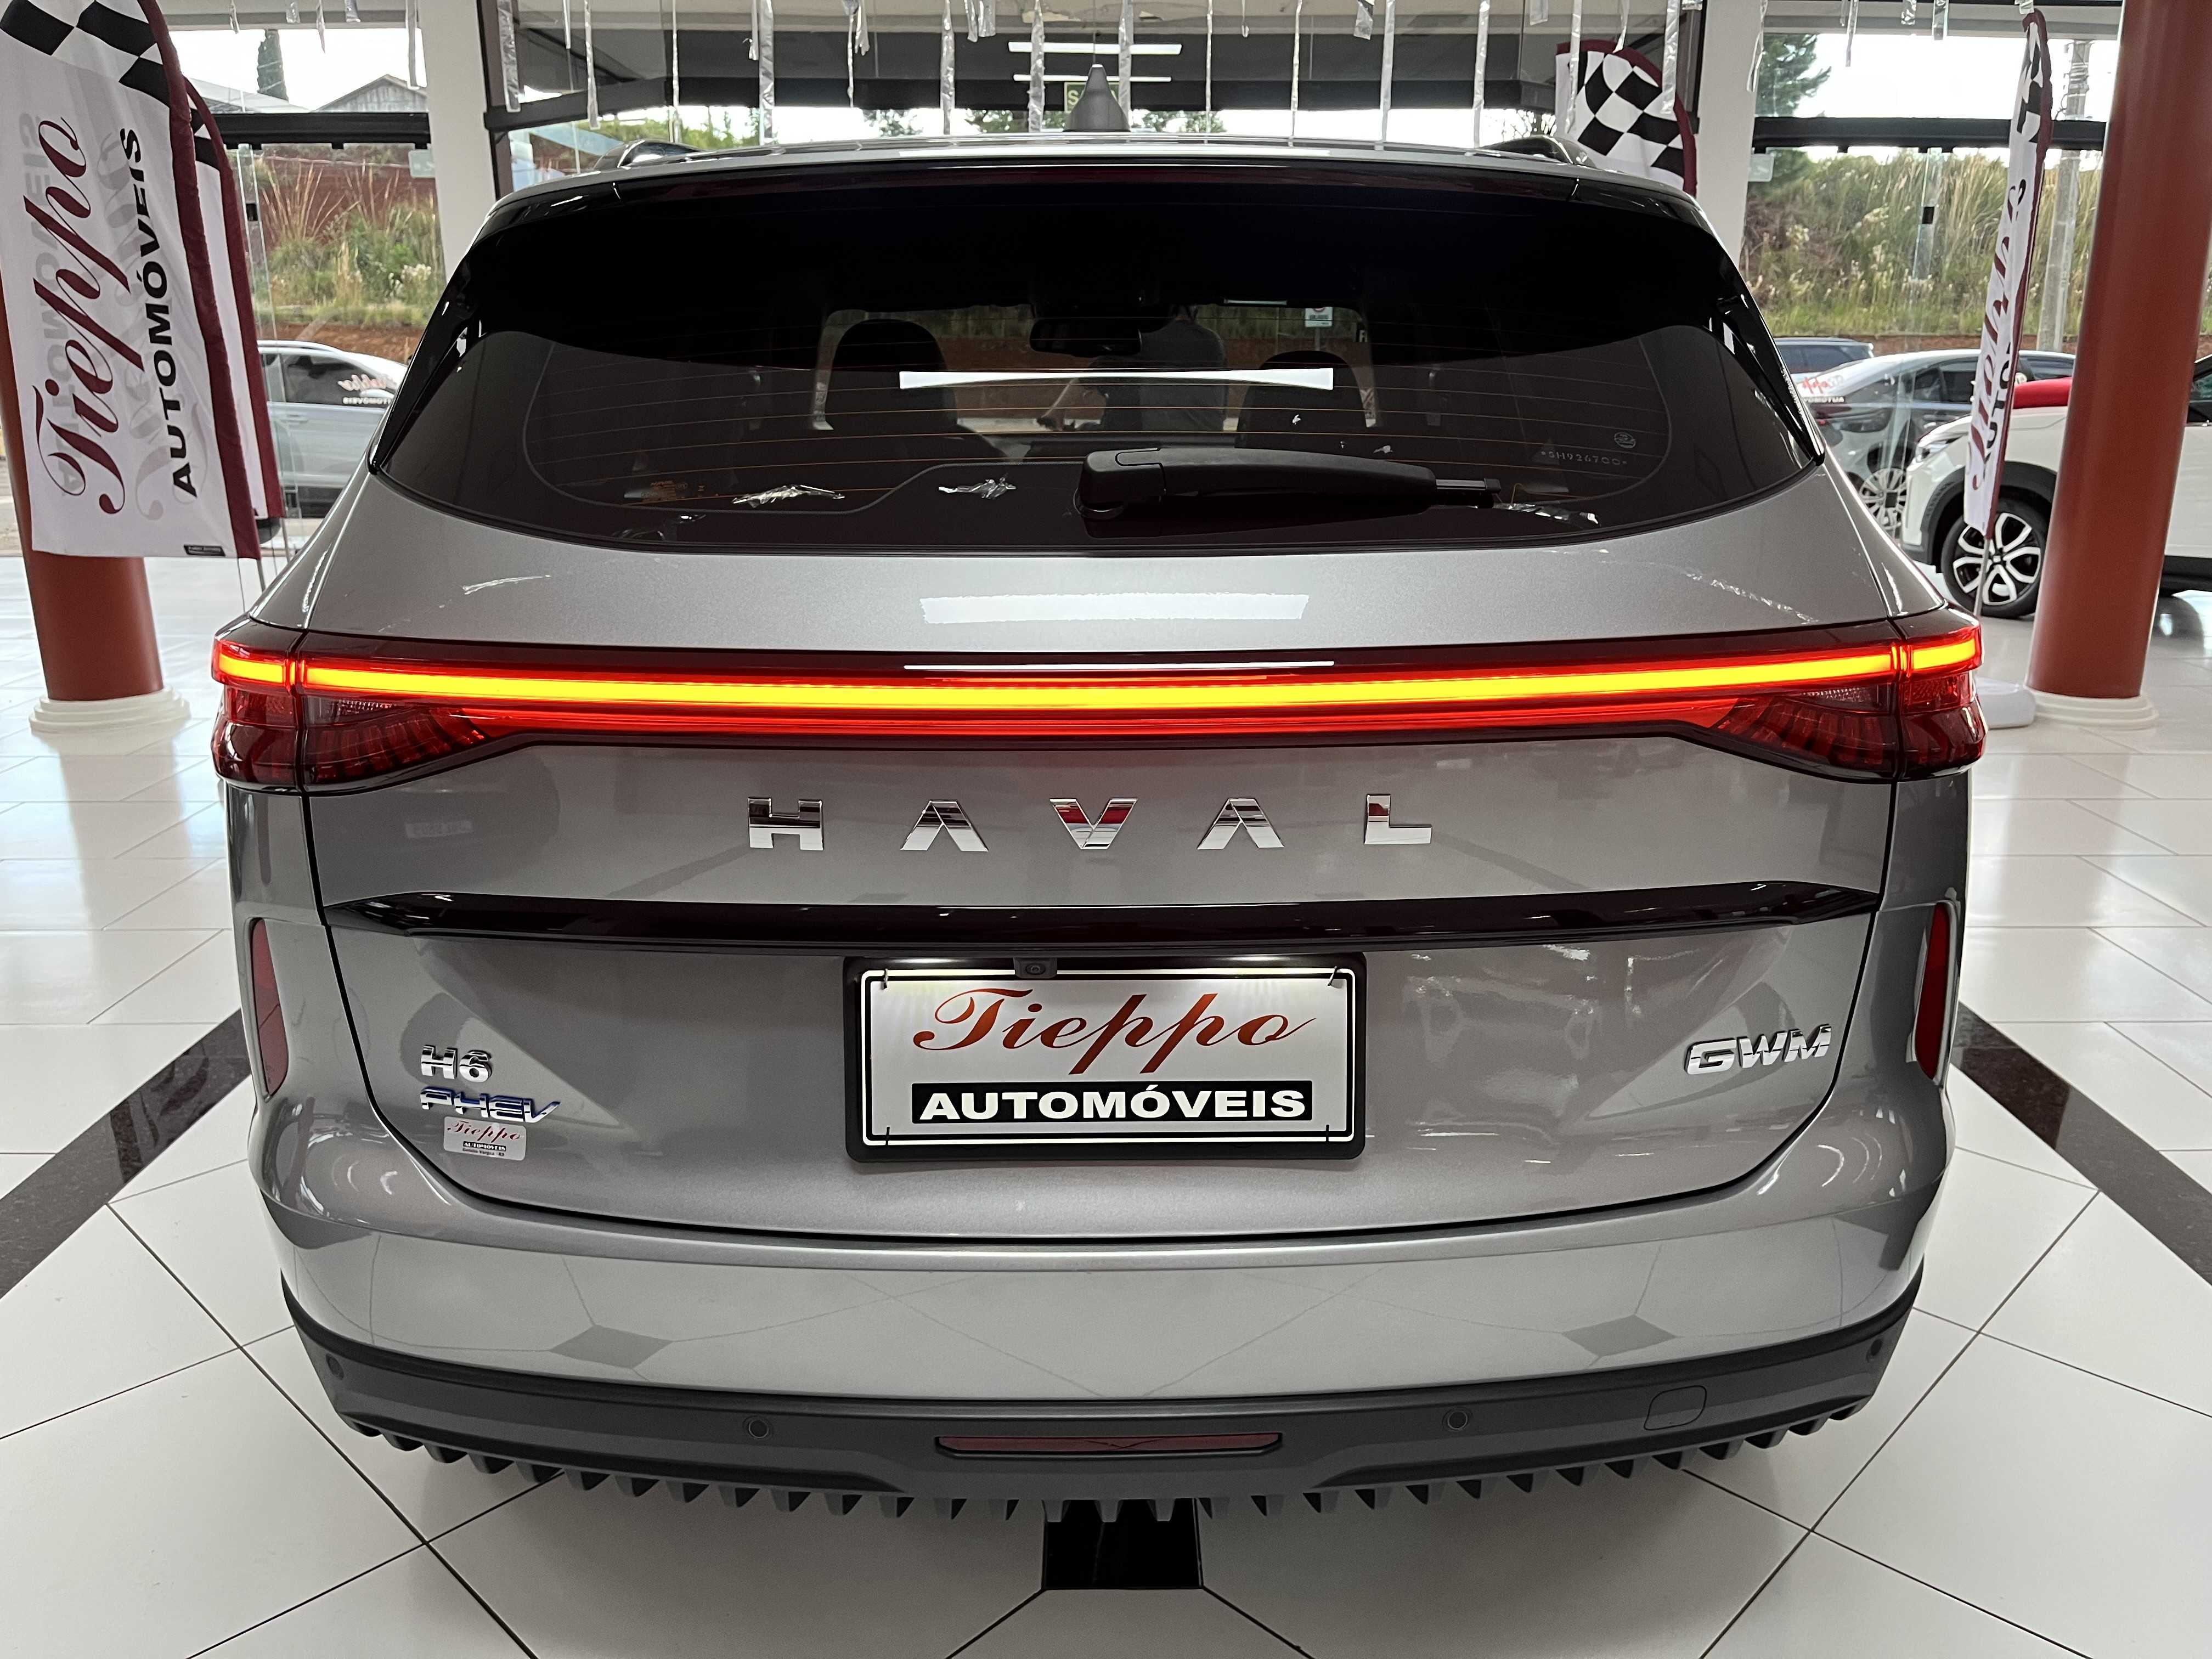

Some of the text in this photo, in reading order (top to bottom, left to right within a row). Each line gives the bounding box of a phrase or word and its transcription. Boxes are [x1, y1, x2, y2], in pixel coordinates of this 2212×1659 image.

[23, 116, 144, 514] Tieppo
[120, 128, 198, 498] AUTOMÓVEIS
[747, 793, 1432, 852] HAVAL
[913, 987, 1317, 1075] Tieppo
[1684, 1023, 1832, 1075] GWM
[420, 1044, 492, 1083] H6
[420, 1086, 561, 1124] PHEV
[919, 1084, 1305, 1121] AUTOMÓVEIS
[447, 1120, 522, 1143] Tieppo
